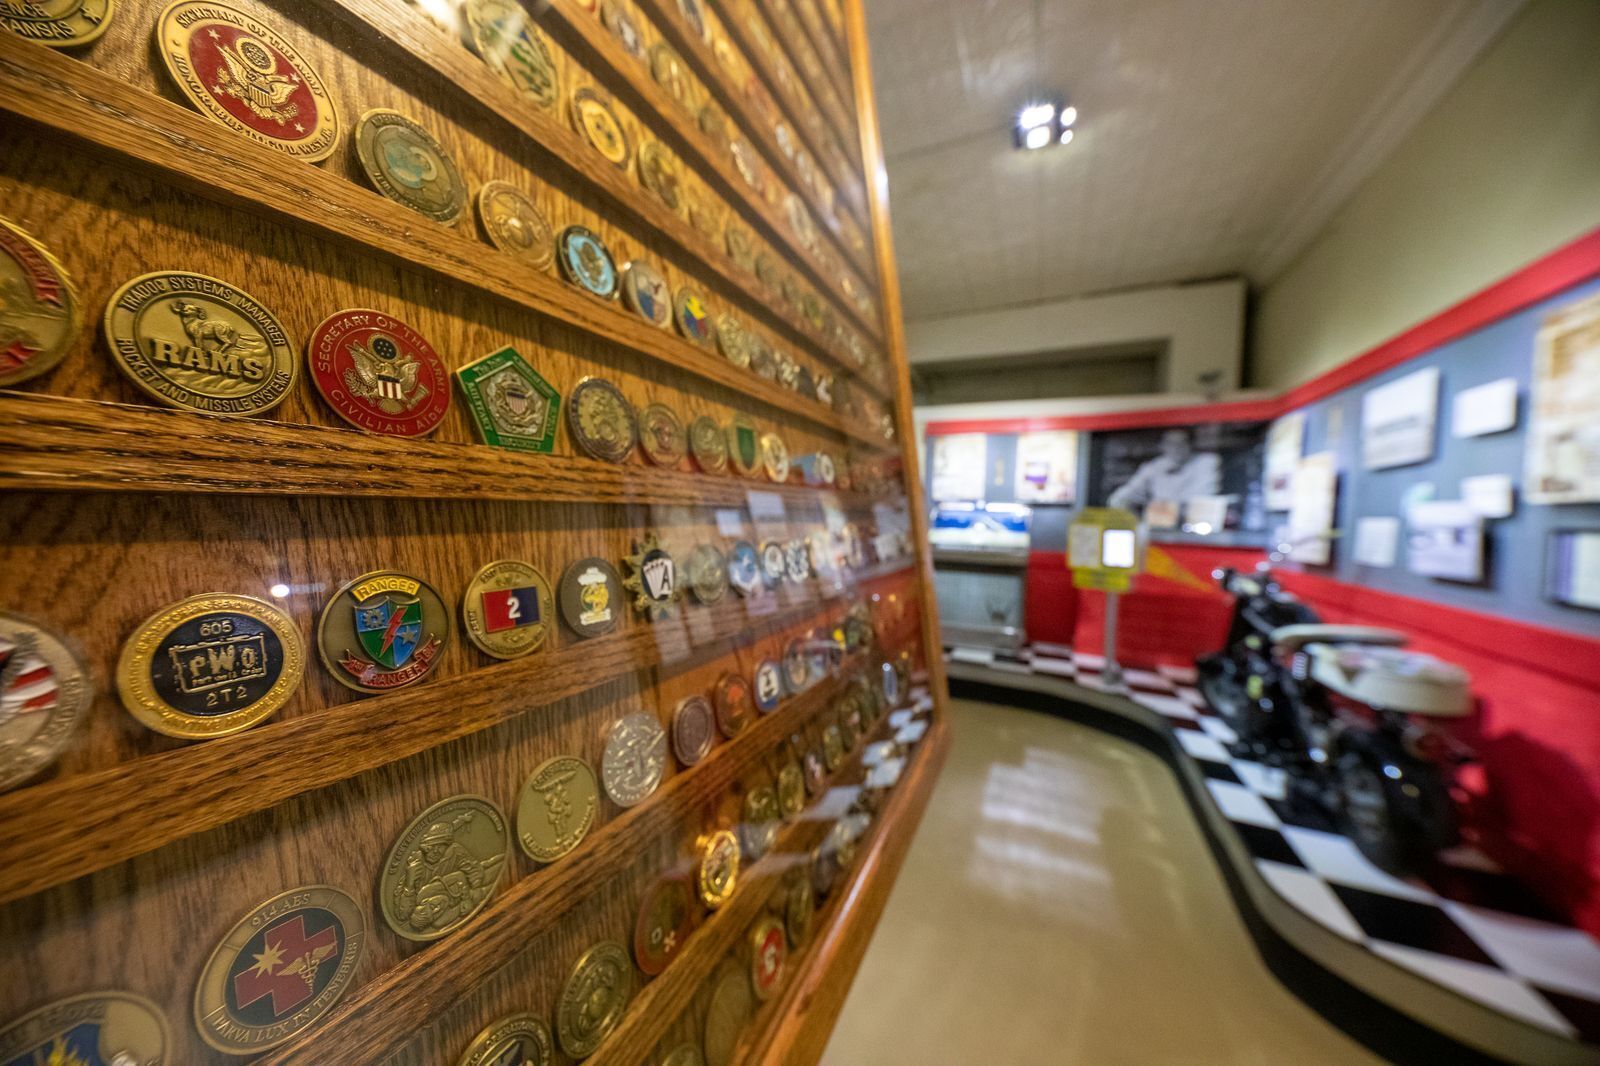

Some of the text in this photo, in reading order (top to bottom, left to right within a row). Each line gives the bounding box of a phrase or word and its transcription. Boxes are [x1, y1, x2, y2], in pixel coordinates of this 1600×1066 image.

[175, 8, 324, 98] SECRETARY OF THE ARMY
[171, 52, 244, 132] HONORABLE
[119, 276, 286, 346] TRADOC SYSTEMS MANAGER
[117, 338, 290, 413] ROCKET AND MISSILE SYSTEMS
[153, 338, 264, 381] RAMS
[318, 315, 447, 395] SECRETARY OF THE ARMY
[331, 389, 443, 433] CIVILIAN AIDE
[357, 578, 417, 599] RANGER
[506, 596, 521, 619] 2
[200, 620, 233, 637] 605
[206, 685, 248, 708] 2T2
[252, 893, 311, 926] 914 AES
[212, 941, 358, 1044] PARVA LUX IN TENEBRIS
